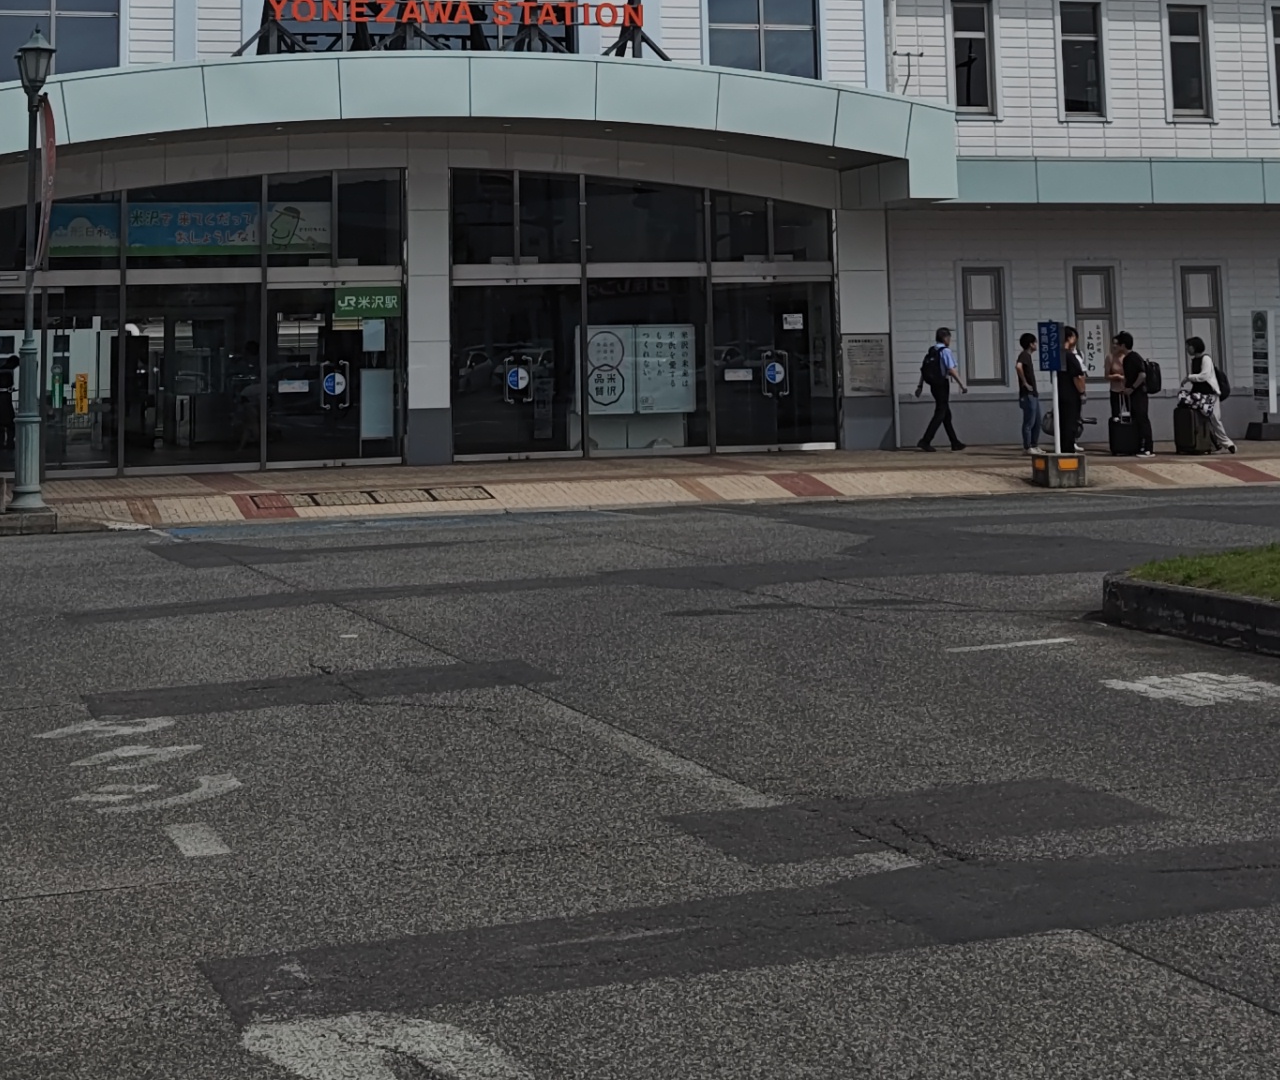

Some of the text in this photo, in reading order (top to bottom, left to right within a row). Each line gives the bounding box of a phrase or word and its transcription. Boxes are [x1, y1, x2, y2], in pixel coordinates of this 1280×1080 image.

[493, 0, 645, 28] STATION
[338, 295, 398, 309] JR 米沢駅
[1087, 331, 1095, 371] よねざわ
